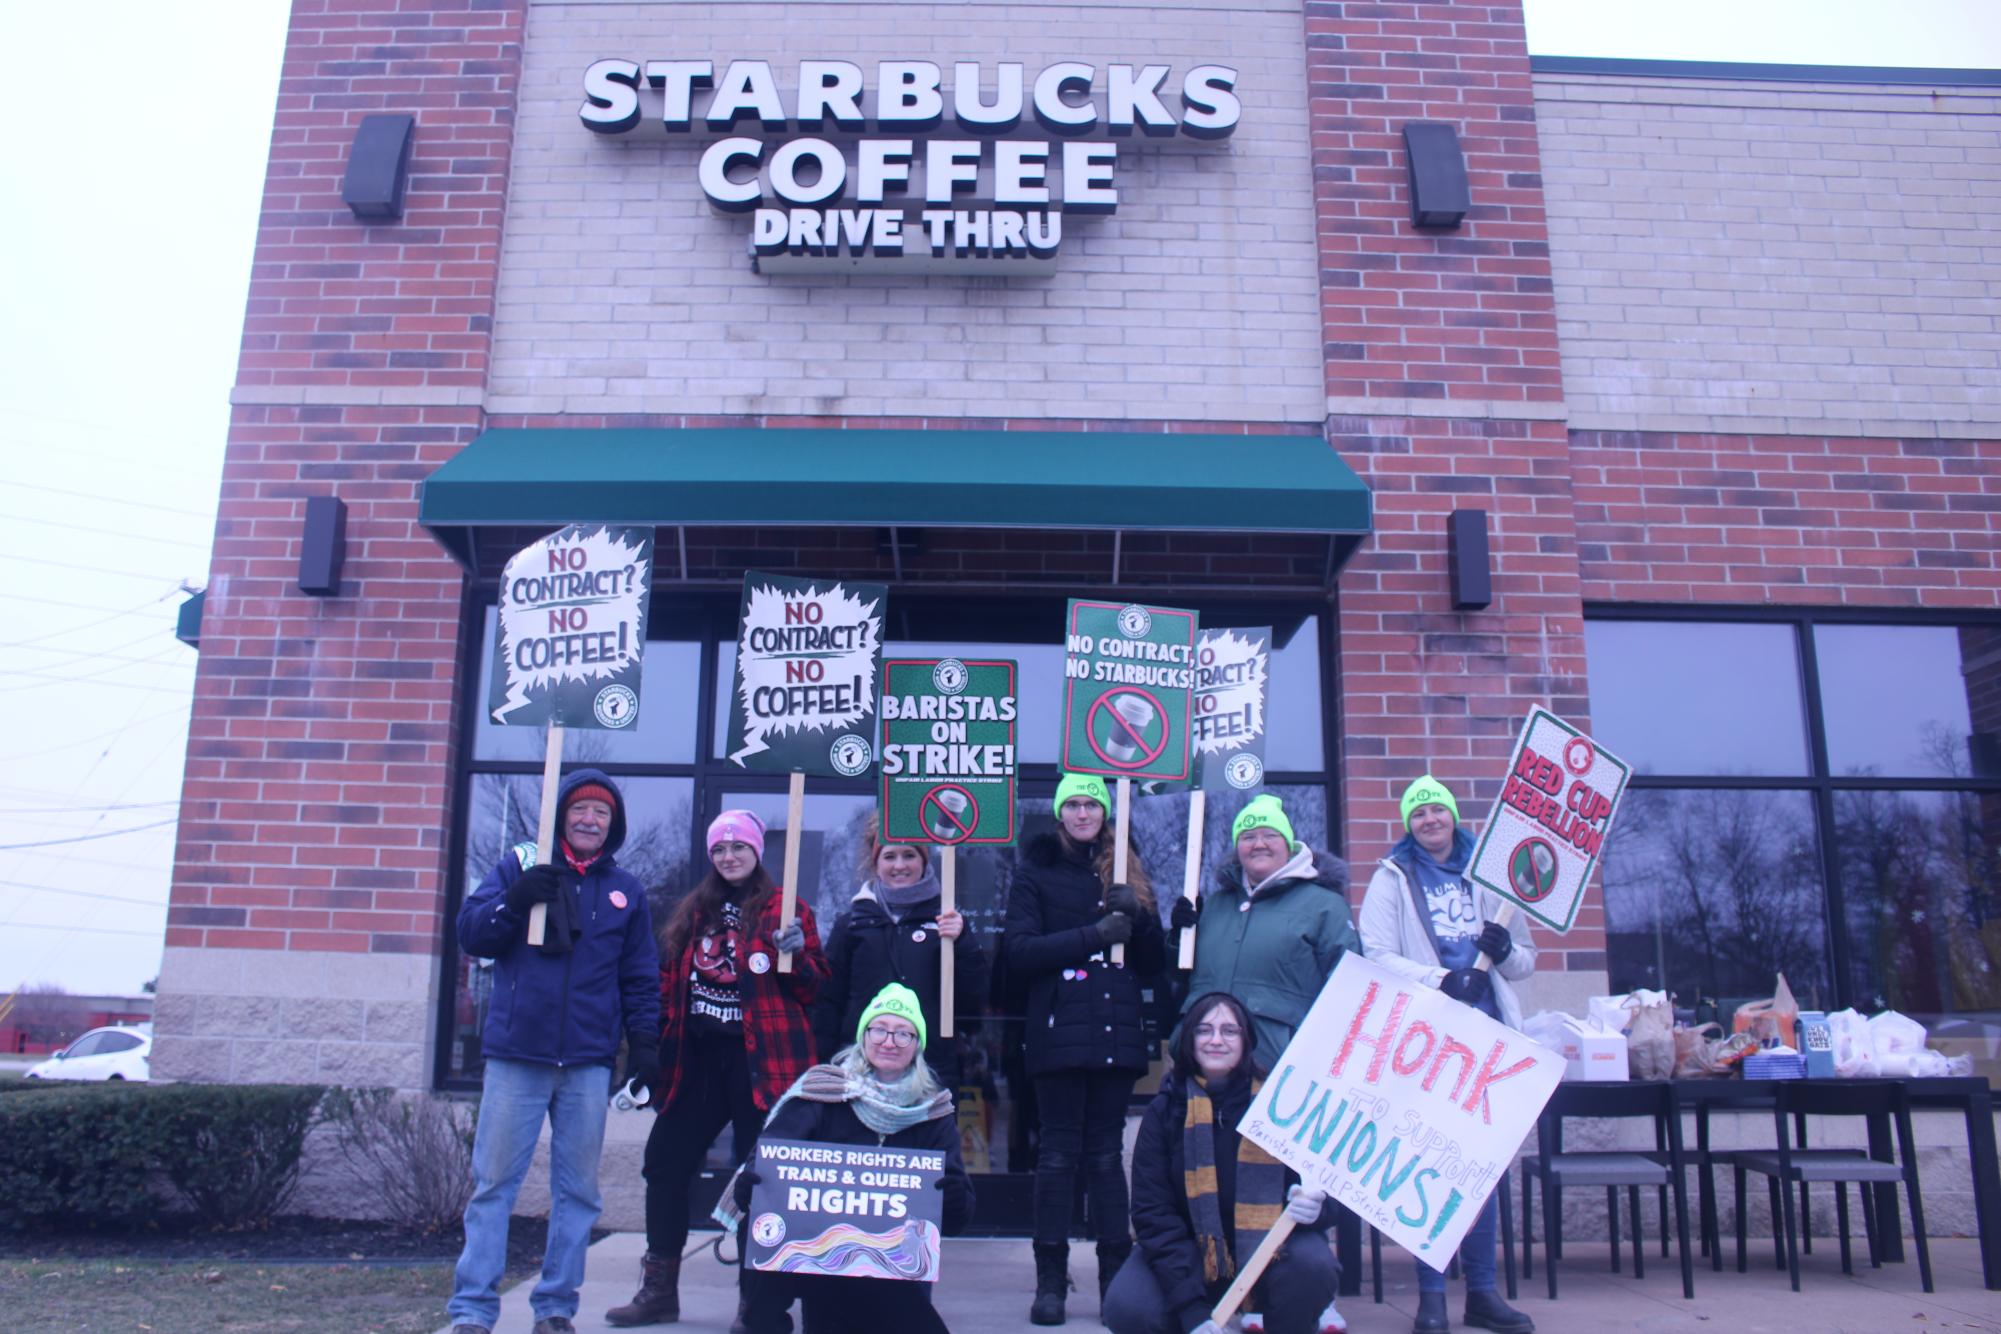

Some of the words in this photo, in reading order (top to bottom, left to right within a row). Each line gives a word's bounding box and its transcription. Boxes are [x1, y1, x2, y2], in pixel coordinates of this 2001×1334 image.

[580, 58, 1241, 137] STARBUCKS
[699, 137, 1117, 211] COFFEE
[753, 208, 903, 254] DRIVE
[923, 210, 1061, 255] THRU
[548, 547, 587, 573] NO
[512, 565, 636, 604] CONTRACT?
[548, 607, 588, 633] NO
[785, 602, 823, 625] NO
[515, 621, 628, 672] COFFEE!
[750, 621, 869, 653] CONTRACT?
[1068, 635, 1093, 655] NO
[1099, 638, 1195, 667] CONTRACT,
[786, 660, 824, 683] NO
[1197, 658, 1257, 687] RACT?
[1200, 648, 1215, 666] O
[1066, 658, 1091, 679] NO
[1094, 661, 1194, 689] STARBUCKS!
[753, 675, 863, 718] COFFEE!
[882, 696, 1016, 722] BARISTAS
[931, 722, 967, 743] ON
[882, 745, 1014, 776] STRIKE!
[1515, 746, 1564, 796] RED
[1567, 780, 1612, 826] CUP
[1502, 775, 1604, 858] REBELLION
[760, 1145, 842, 1164] WORKERS
[846, 1151, 906, 1168] RIGHTS
[908, 1156, 942, 1170] ARE
[1247, 1120, 1295, 1161] Baristas
[1302, 1160, 1314, 1173] on
[1319, 1167, 1353, 1196] ULP
[1267, 1065, 1464, 1250] UNIONS!
[777, 1166, 837, 1183] TRANS
[841, 1171, 855, 1185] &
[860, 1172, 922, 1189] QUEER
[788, 1187, 908, 1218] RIGHTS
